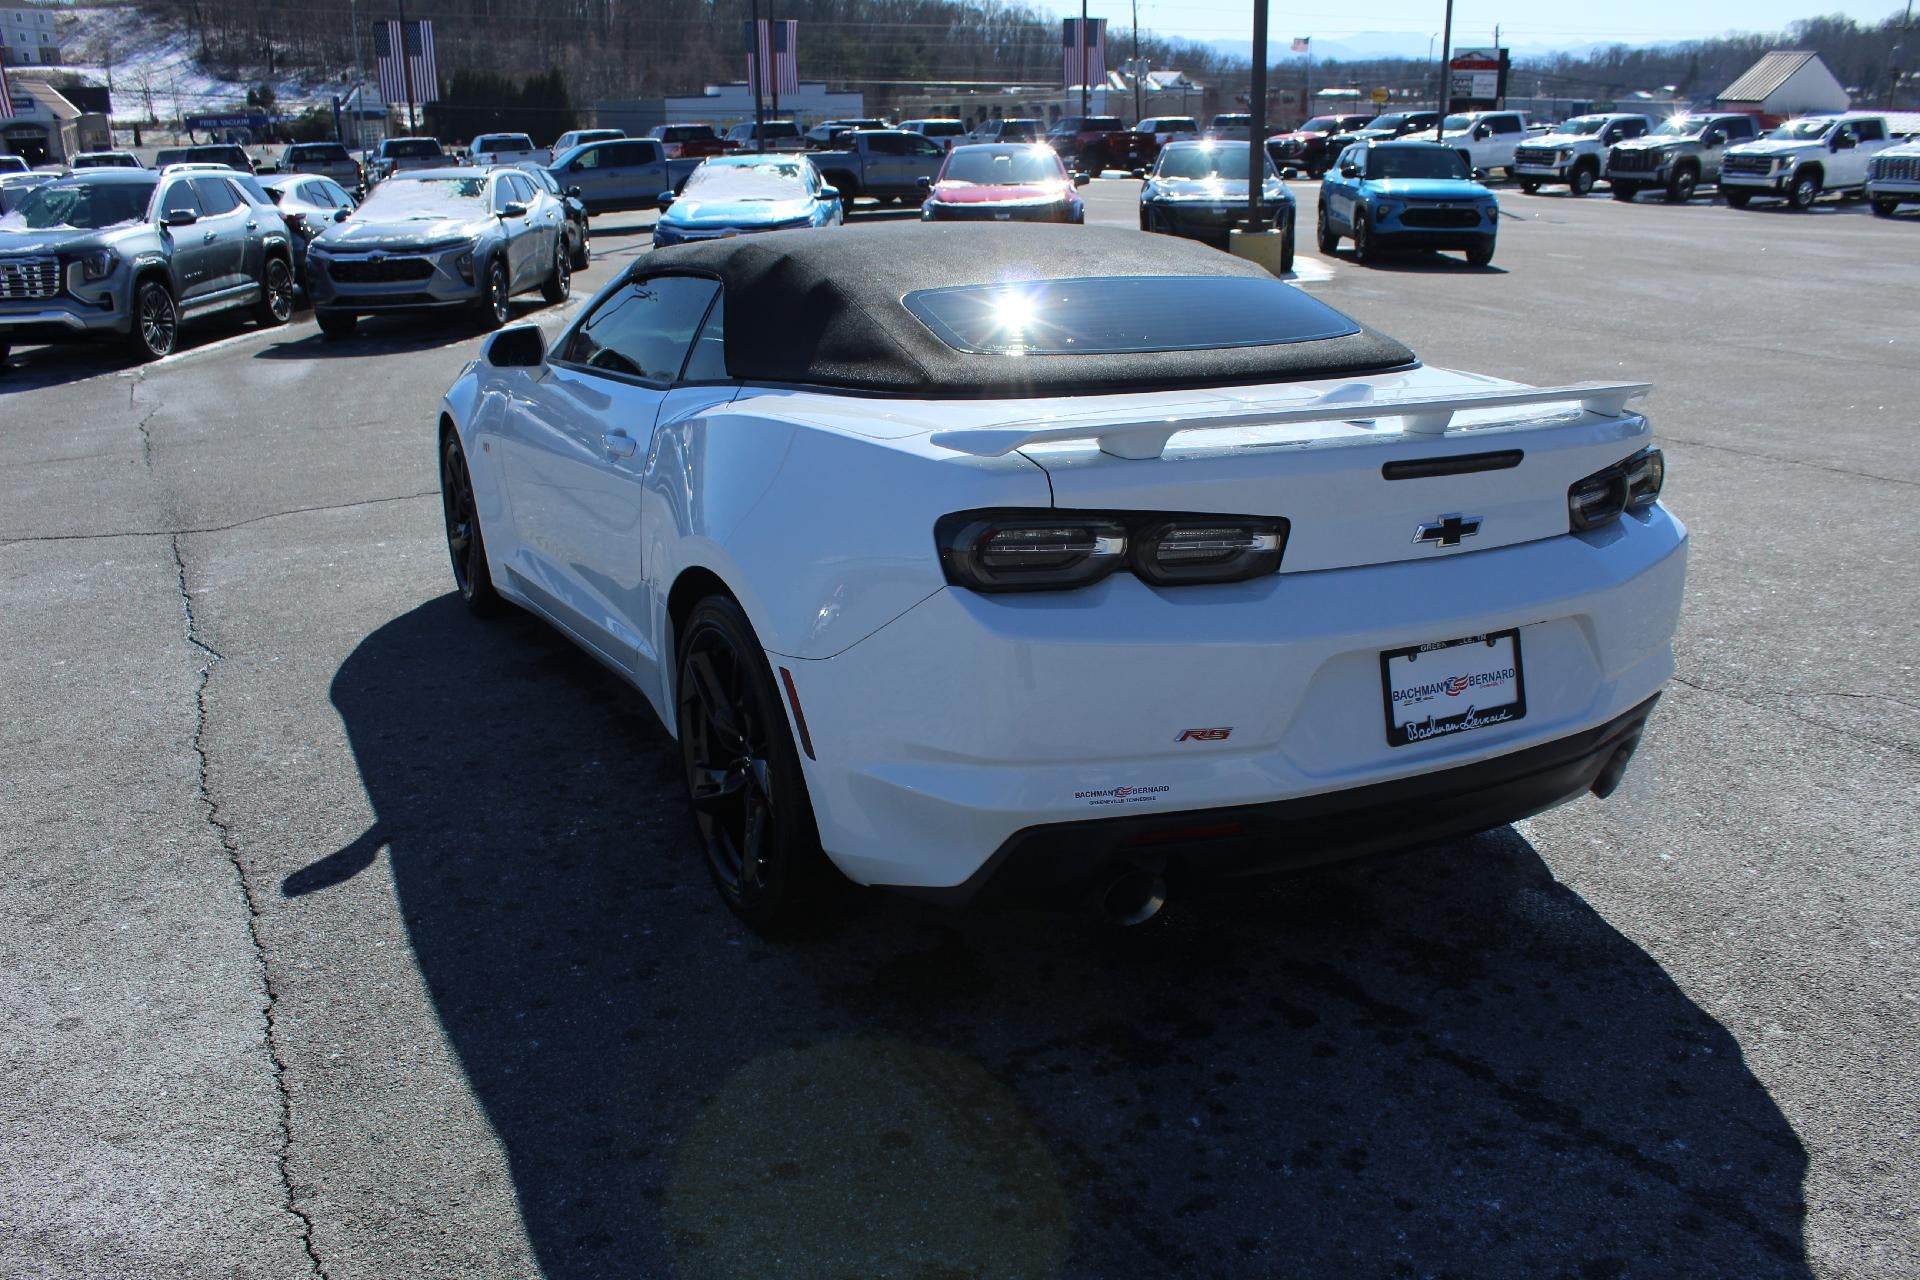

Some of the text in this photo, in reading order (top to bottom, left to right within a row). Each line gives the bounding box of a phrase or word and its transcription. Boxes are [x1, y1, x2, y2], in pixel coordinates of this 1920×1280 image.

[199, 118, 250, 127] FREE VACUUM
[1392, 682, 1444, 702] BACHMAN
[1469, 667, 1515, 687] BERNARD
[1175, 726, 1234, 743] RS
[1074, 785, 1170, 799] BACHMAN BERNARD
